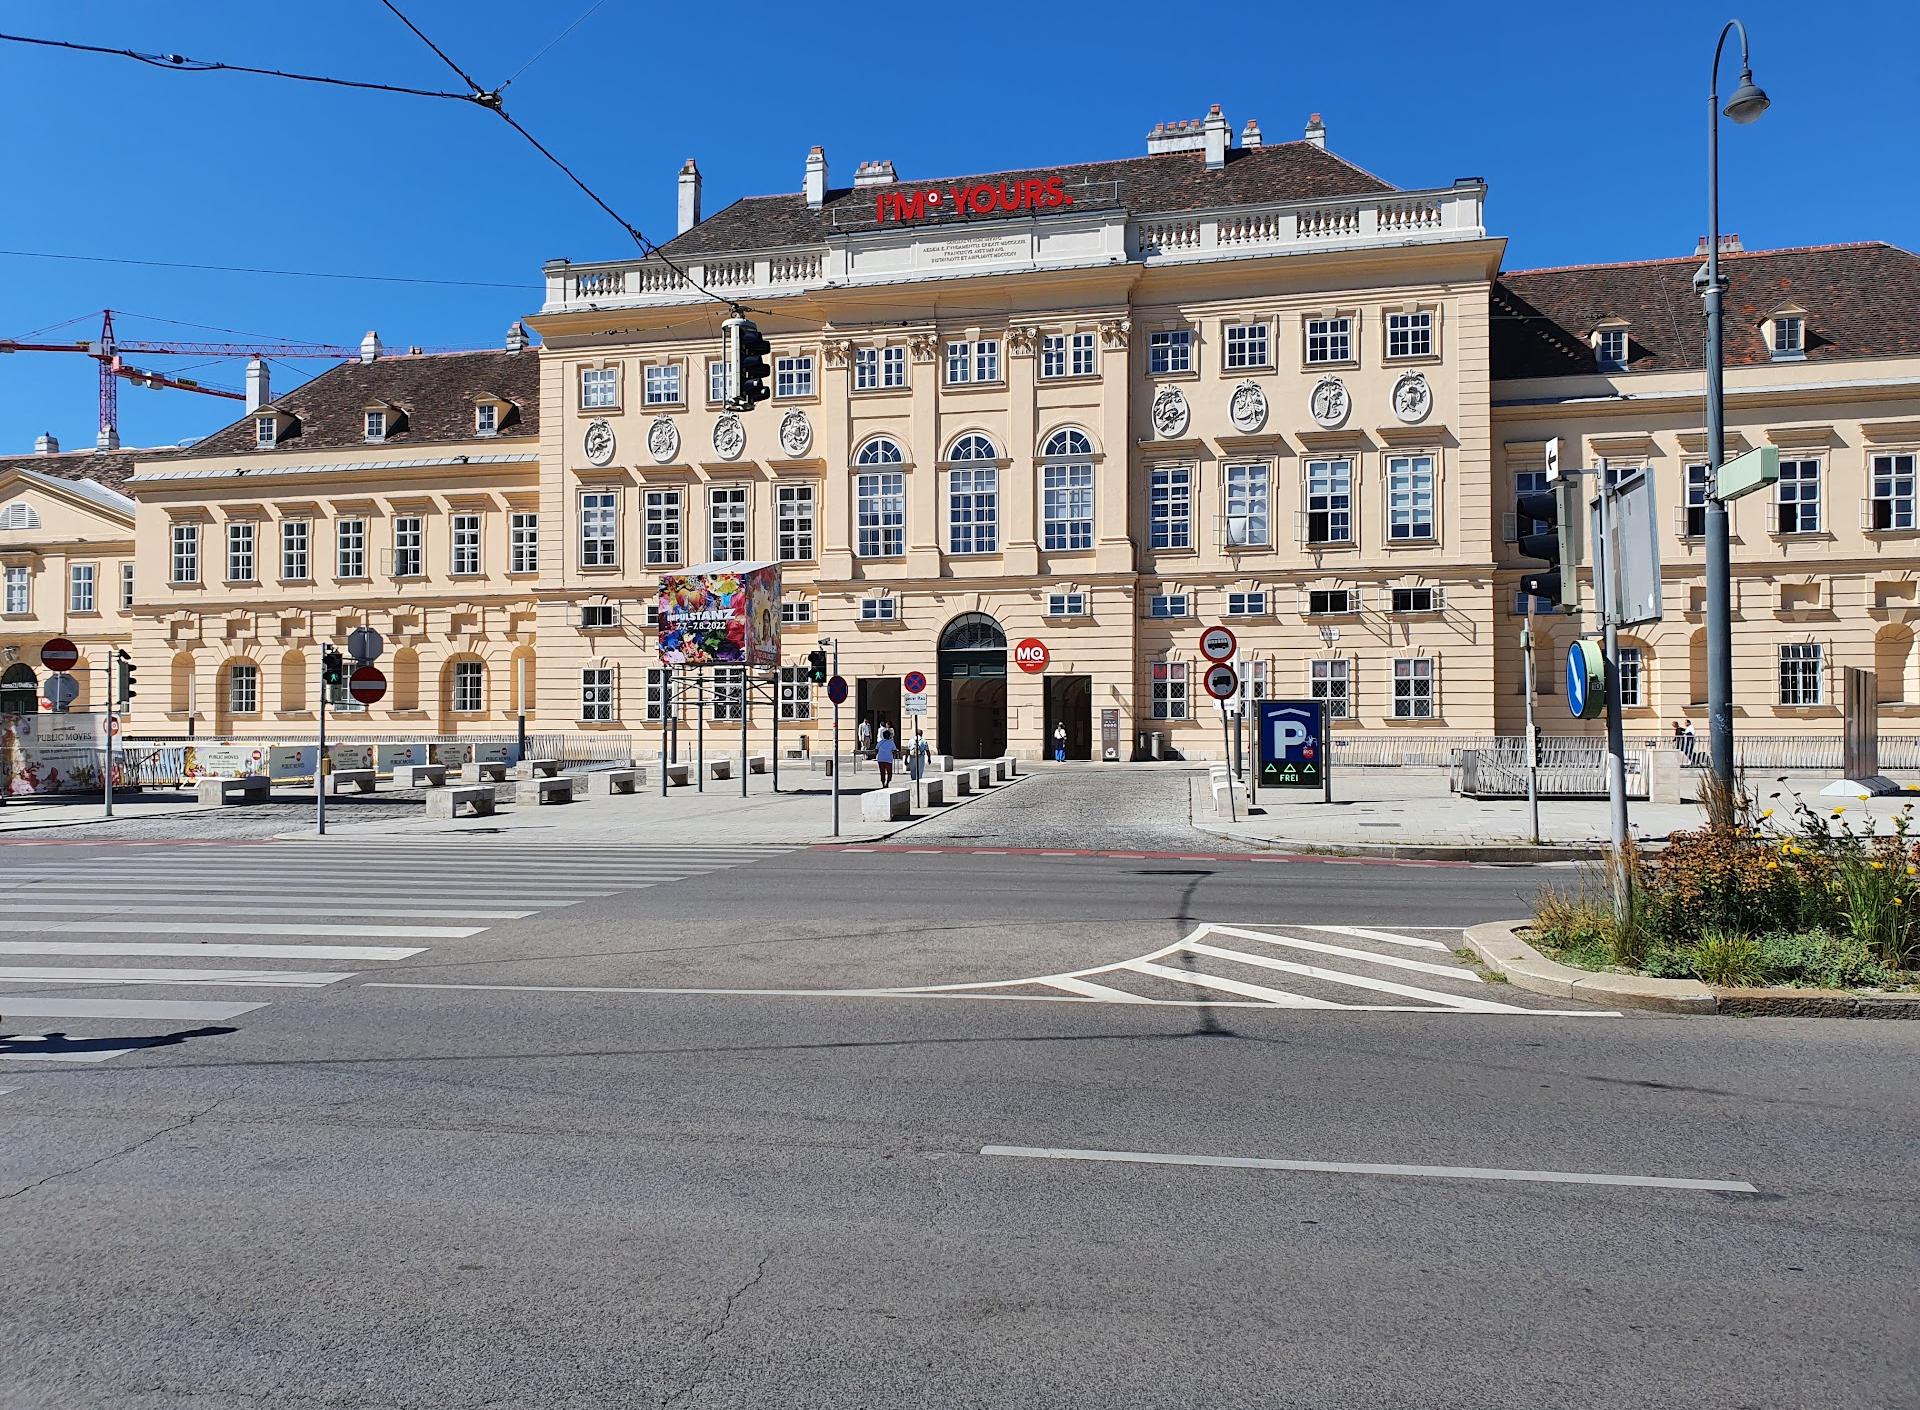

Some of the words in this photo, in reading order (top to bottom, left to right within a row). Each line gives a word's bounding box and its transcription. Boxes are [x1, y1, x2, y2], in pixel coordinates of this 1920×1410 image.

[949, 176, 1074, 216] YOURS.
[667, 608, 736, 621] IMPULSTANZ
[1017, 646, 1044, 661] MQ
[37, 734, 64, 742] PUBLIC
[65, 732, 92, 741] MOVES
[1274, 720, 1307, 759] P
[1279, 774, 1299, 782] FREI
